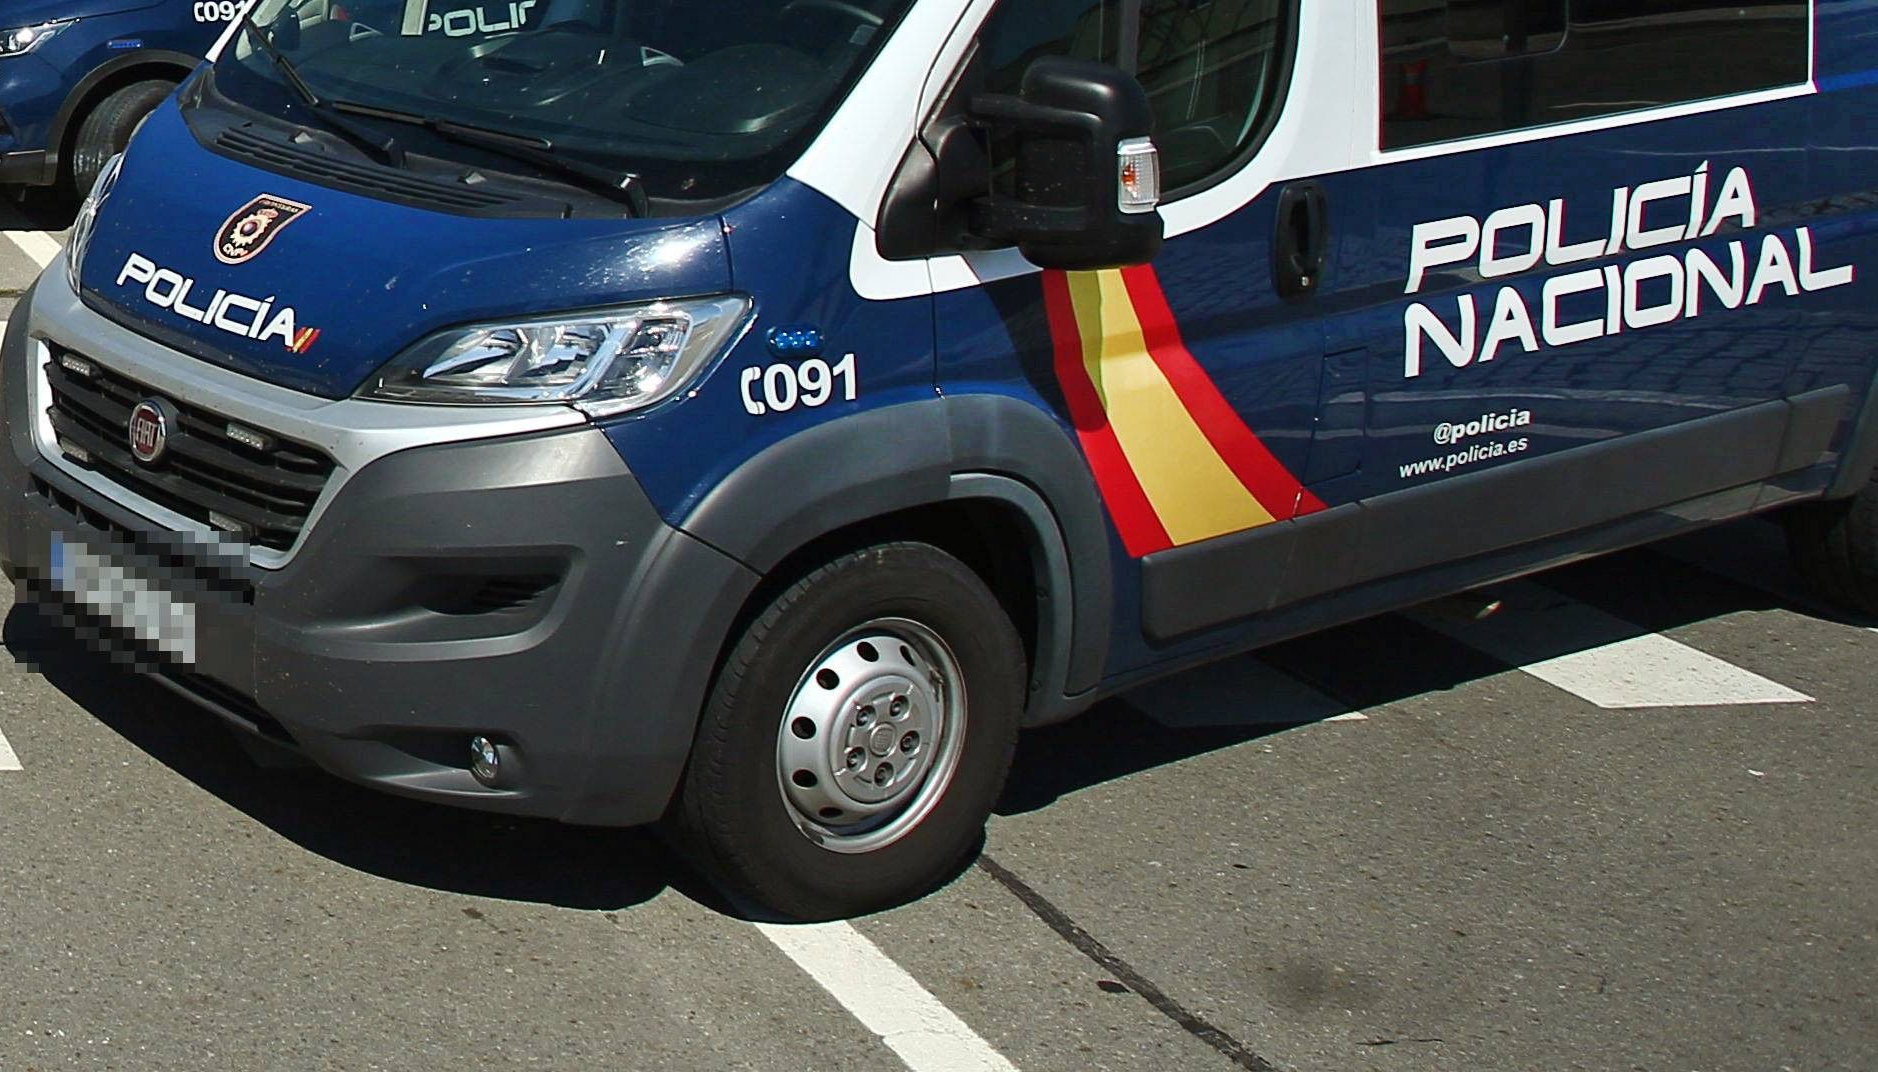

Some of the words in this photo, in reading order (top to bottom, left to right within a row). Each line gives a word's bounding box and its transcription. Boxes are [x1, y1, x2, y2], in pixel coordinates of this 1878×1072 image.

[1404, 160, 1758, 294] POLICÍA
[116, 252, 294, 348] POLICÍA
[1404, 226, 1855, 378] NACIONAL
[763, 353, 857, 412] 091
[1399, 437, 1529, 479] www.policia.es
[1433, 408, 1532, 445] @policia
